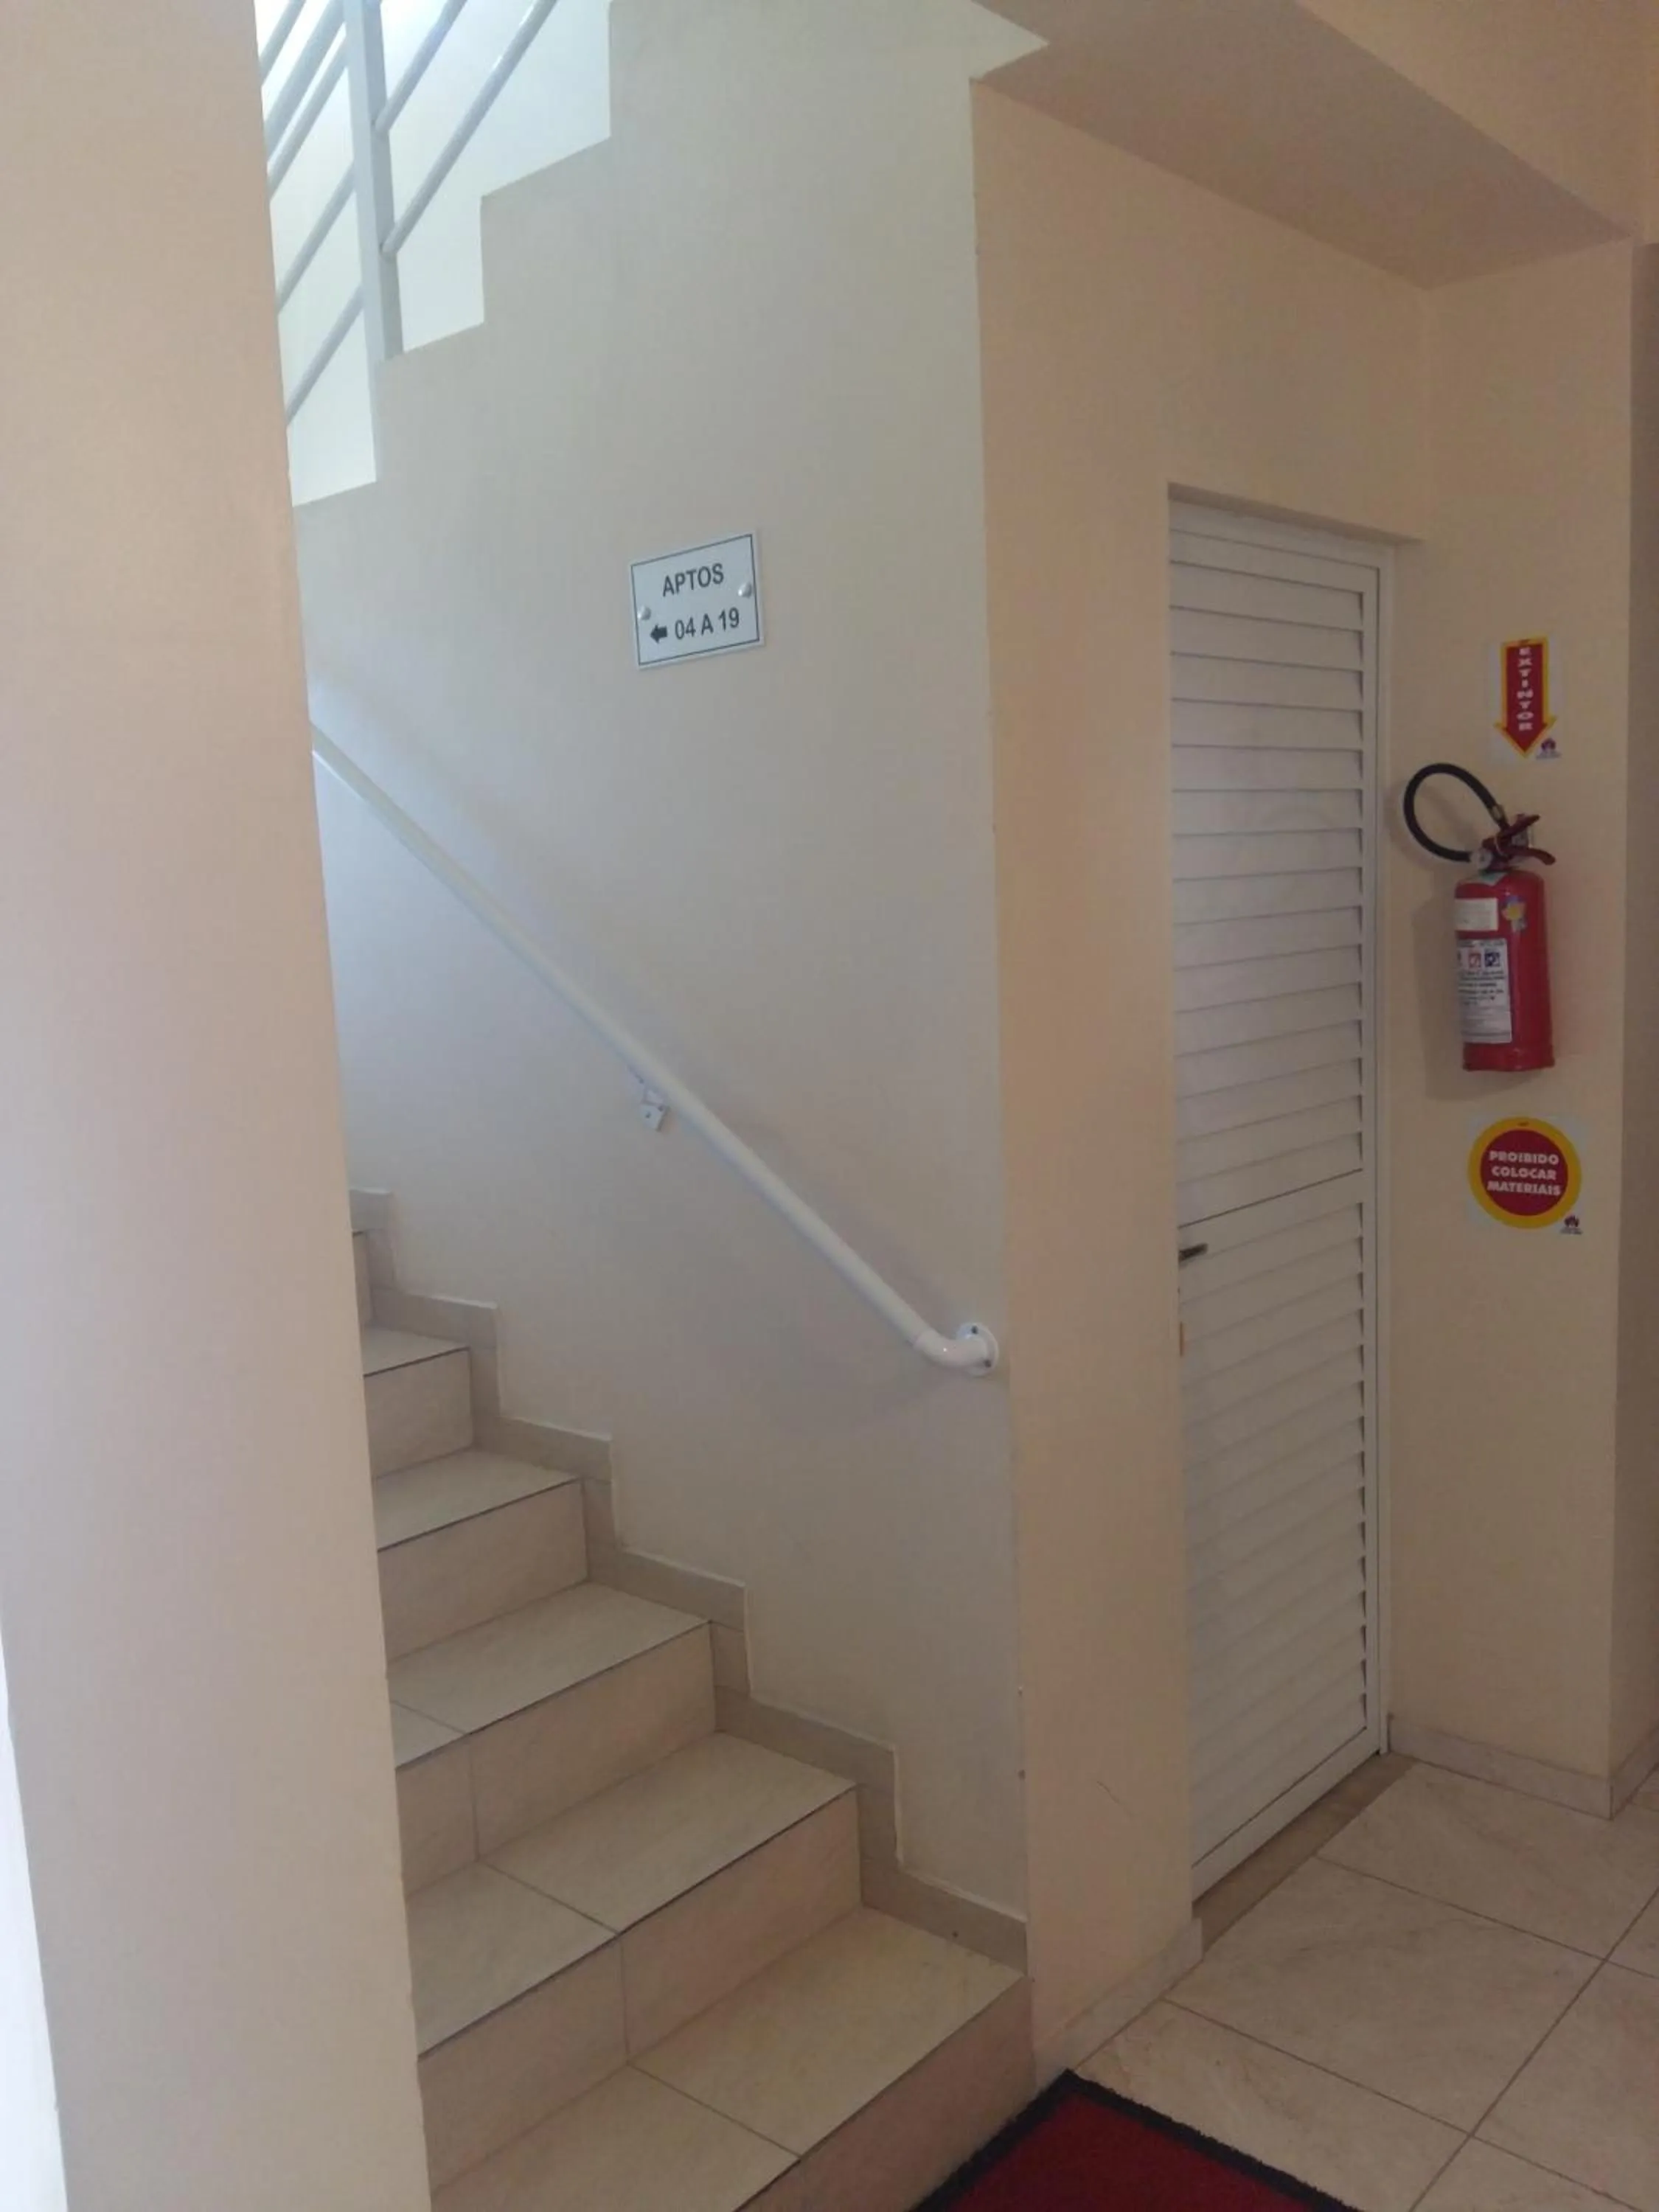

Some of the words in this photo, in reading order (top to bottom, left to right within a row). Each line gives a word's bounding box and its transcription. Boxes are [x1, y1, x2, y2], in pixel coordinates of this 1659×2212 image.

[663, 563, 724, 597] APTOS
[675, 616, 696, 640] 04
[701, 613, 714, 636] A
[718, 607, 740, 631] 19
[1517, 647, 1534, 731] EXTINTOR
[1489, 1150, 1559, 1165] PROIBIDO
[1492, 1166, 1557, 1180] COLOCAR
[1487, 1180, 1561, 1196] MATERIAIS
